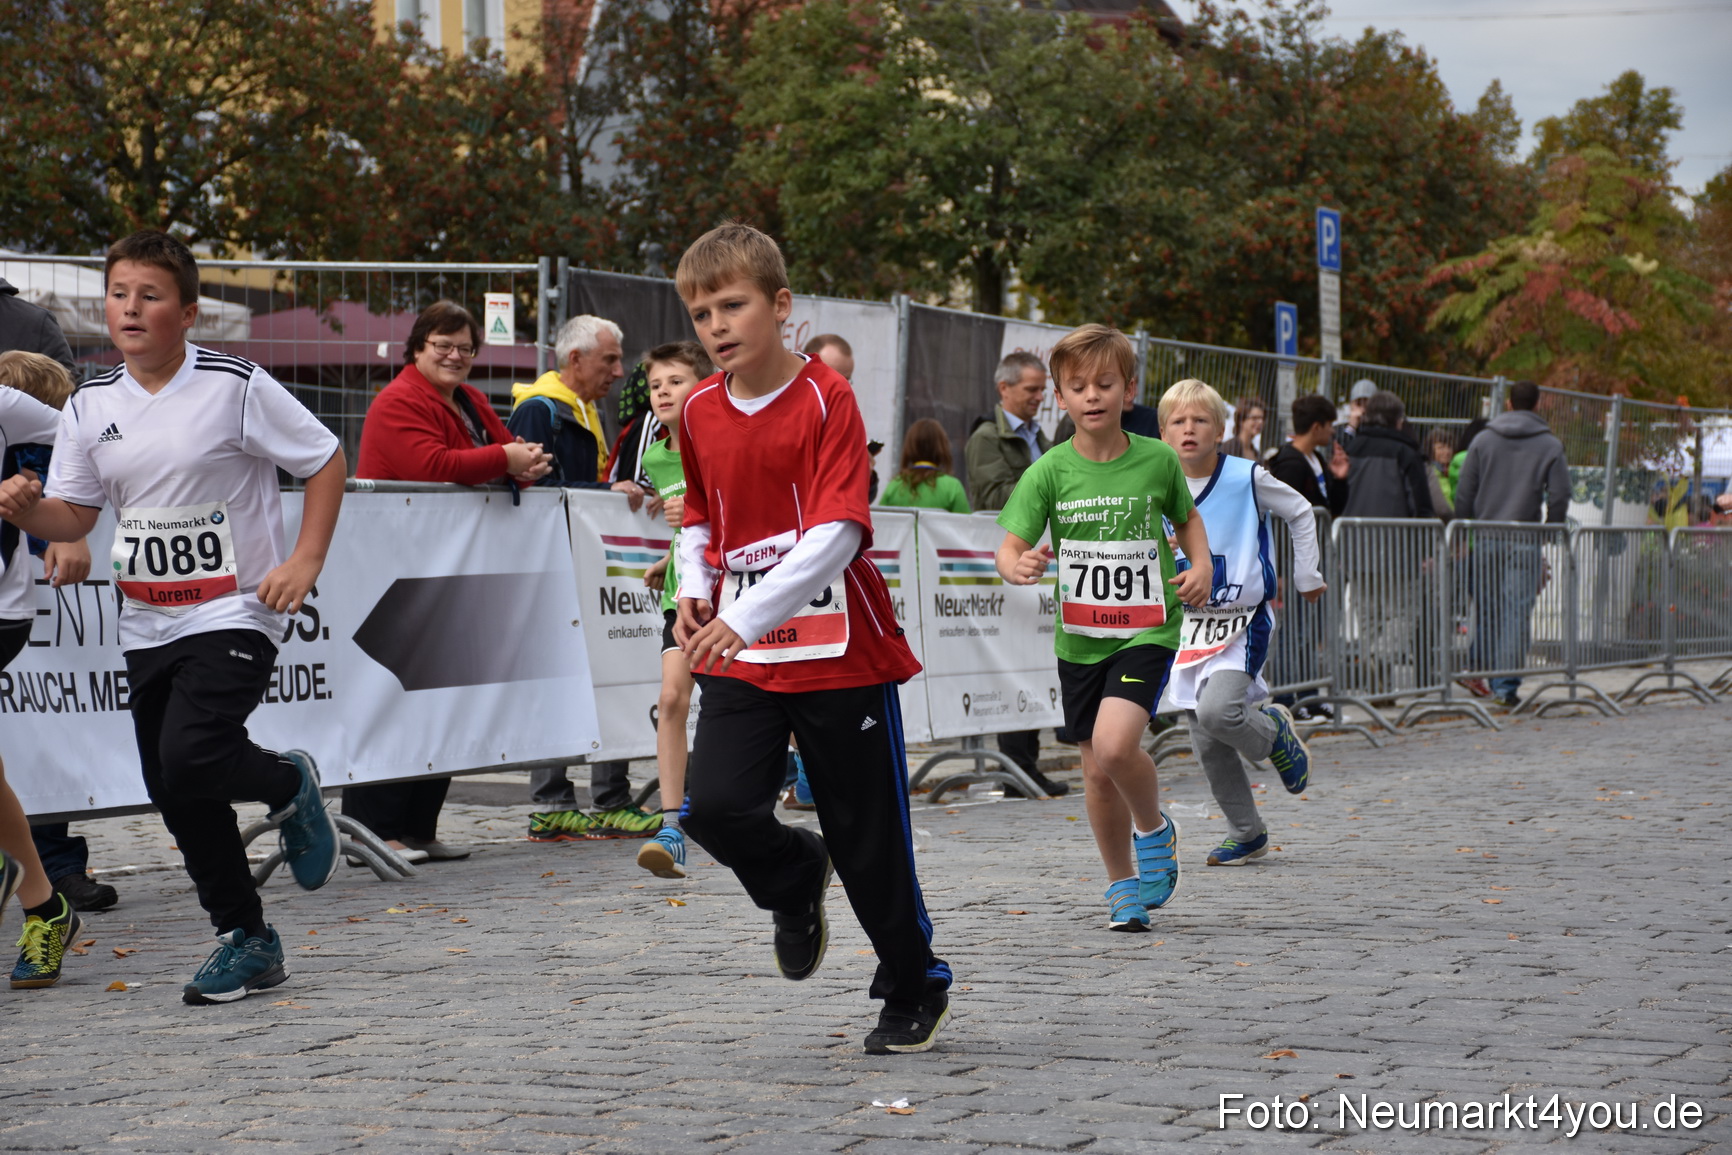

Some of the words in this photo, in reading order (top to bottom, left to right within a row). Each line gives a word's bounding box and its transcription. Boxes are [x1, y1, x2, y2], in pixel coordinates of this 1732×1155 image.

[1321, 216, 1336, 262] P
[1280, 311, 1293, 356] P
[1056, 496, 1123, 511] Neumarkter
[119, 520, 145, 530] ARTL
[148, 517, 206, 530] Neumarkt
[1057, 510, 1109, 523] Stadtlauf
[124, 531, 223, 577] 7089
[745, 545, 777, 566] DEHN
[1061, 549, 1095, 559] PARTL
[1097, 550, 1145, 560] Neumarkt
[1069, 564, 1150, 602] 7091
[148, 587, 203, 603] Lorenz
[935, 592, 1005, 618] NeuerMarkt
[1092, 610, 1130, 625] Louis
[608, 625, 653, 640] einkaufen
[89, 670, 131, 712] ME
[260, 663, 332, 704] EUDE.
